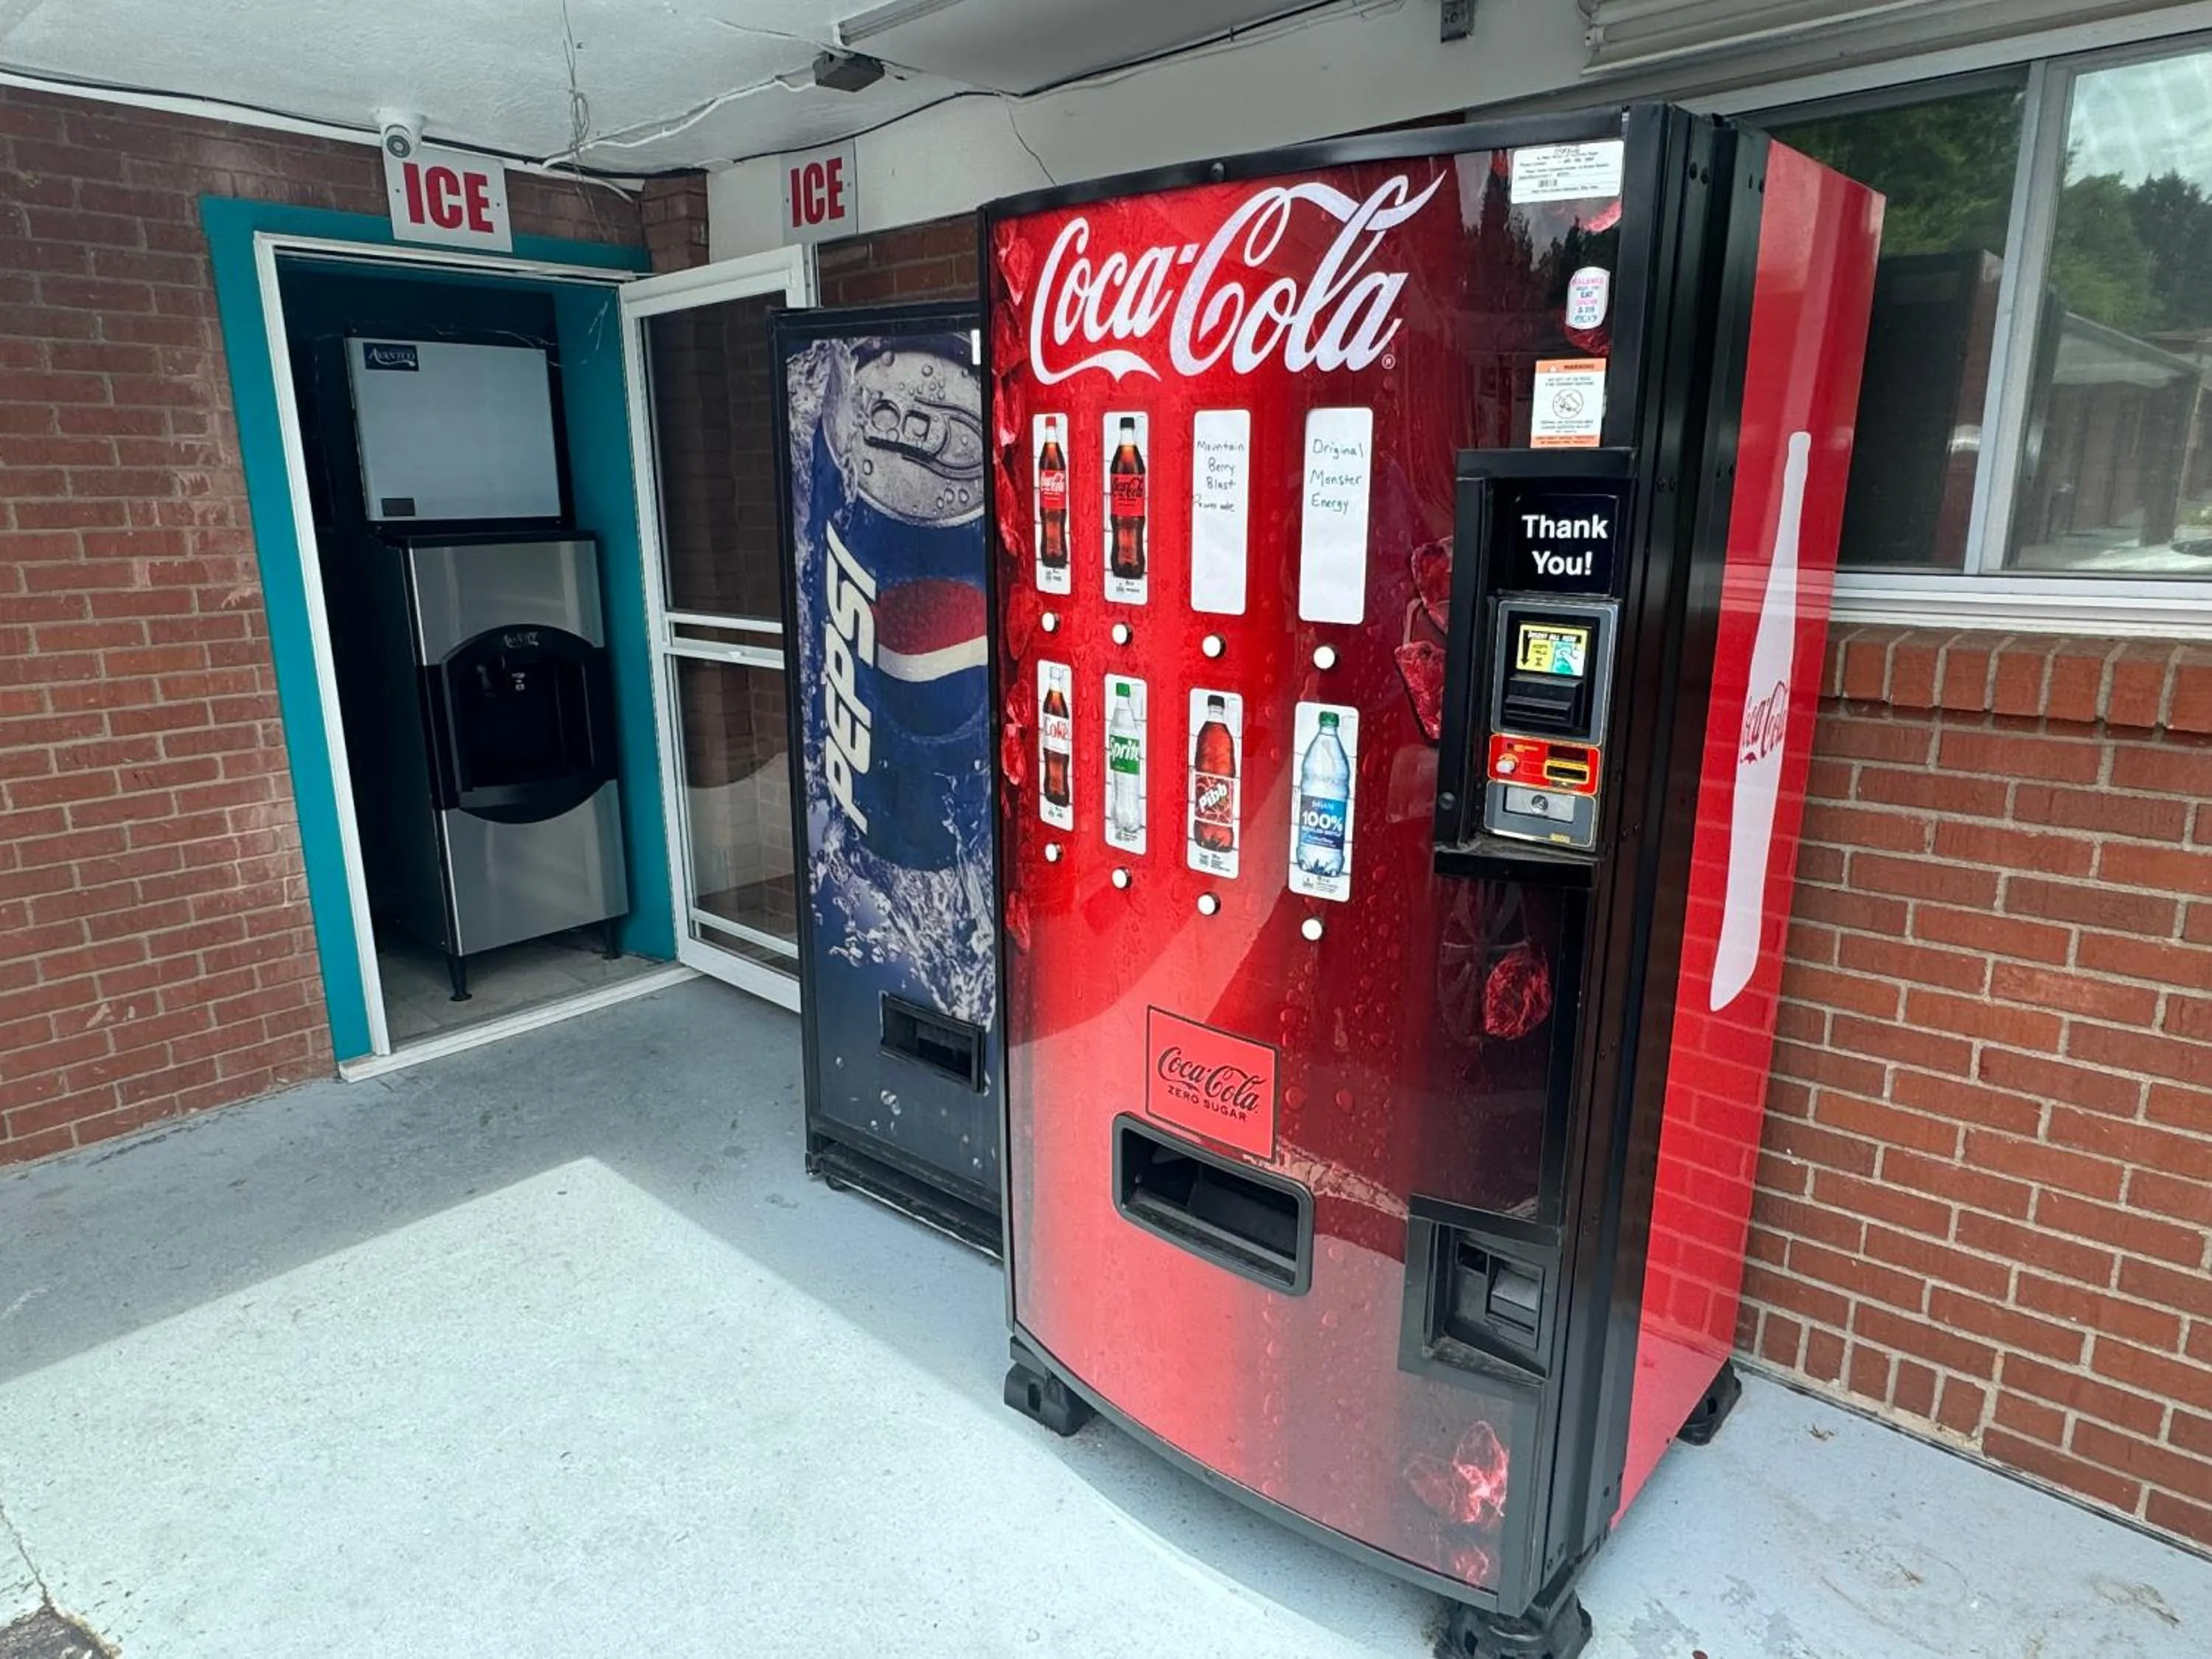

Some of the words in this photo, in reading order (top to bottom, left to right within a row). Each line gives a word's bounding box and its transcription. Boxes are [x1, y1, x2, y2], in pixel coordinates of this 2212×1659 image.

[402, 161, 495, 234] ICE
[790, 157, 846, 228] ICE
[1030, 169, 1447, 386] Coca-Cola
[1197, 439, 1245, 453] Mountain
[1312, 438, 1364, 460] Original
[1208, 456, 1236, 476] Berry
[1310, 469, 1363, 487] Monster
[1206, 476, 1237, 490] Blast
[1310, 493, 1350, 515] Energy
[1522, 514, 1608, 540] Thank
[1532, 551, 1593, 576] You!
[825, 520, 877, 834] PEPSI
[1198, 782, 1228, 813] Pibb
[1302, 810, 1343, 832] 100%
[1158, 1046, 1267, 1113] Coca-Cola
[1168, 1085, 1200, 1105] ZERO
[1203, 1099, 1247, 1121] SUGAR
